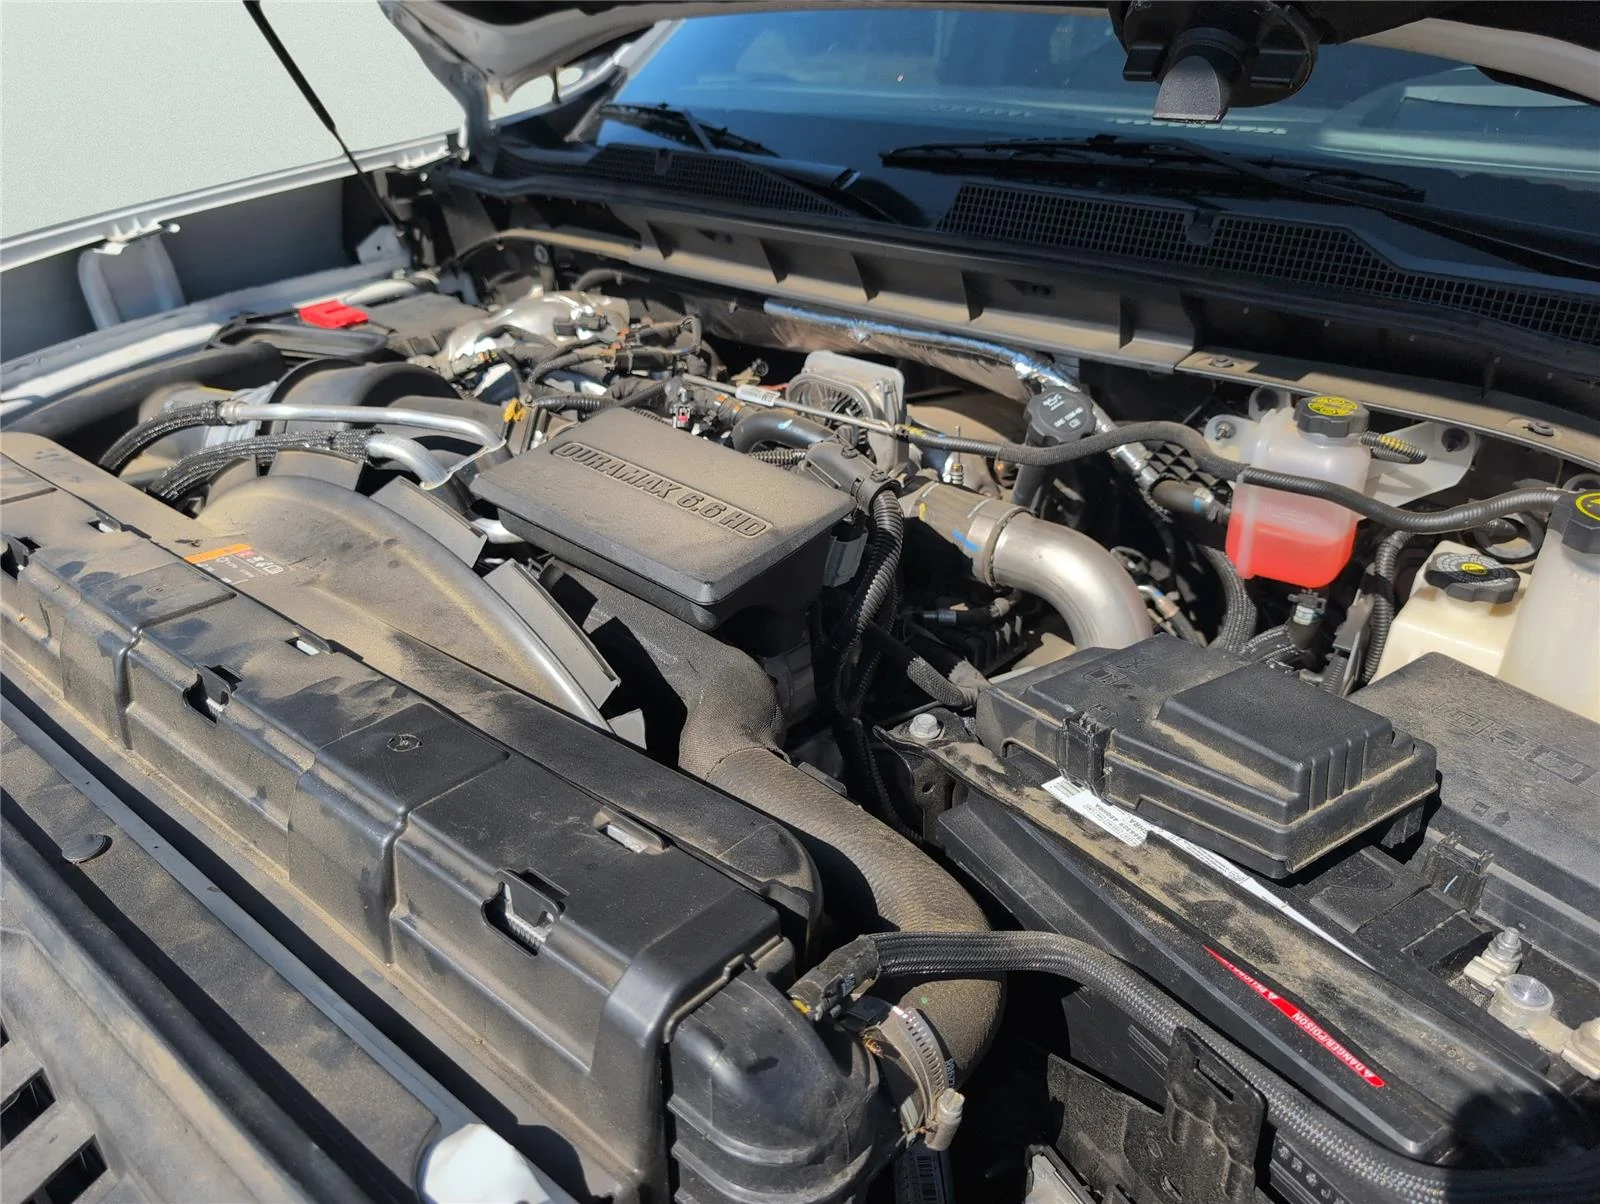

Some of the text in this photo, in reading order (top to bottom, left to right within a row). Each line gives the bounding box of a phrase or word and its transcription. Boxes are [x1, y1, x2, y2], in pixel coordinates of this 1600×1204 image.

[557, 443, 767, 537] DURAMAX 6.6 HD
[1292, 1012, 1364, 1073] DANGER/POISON
